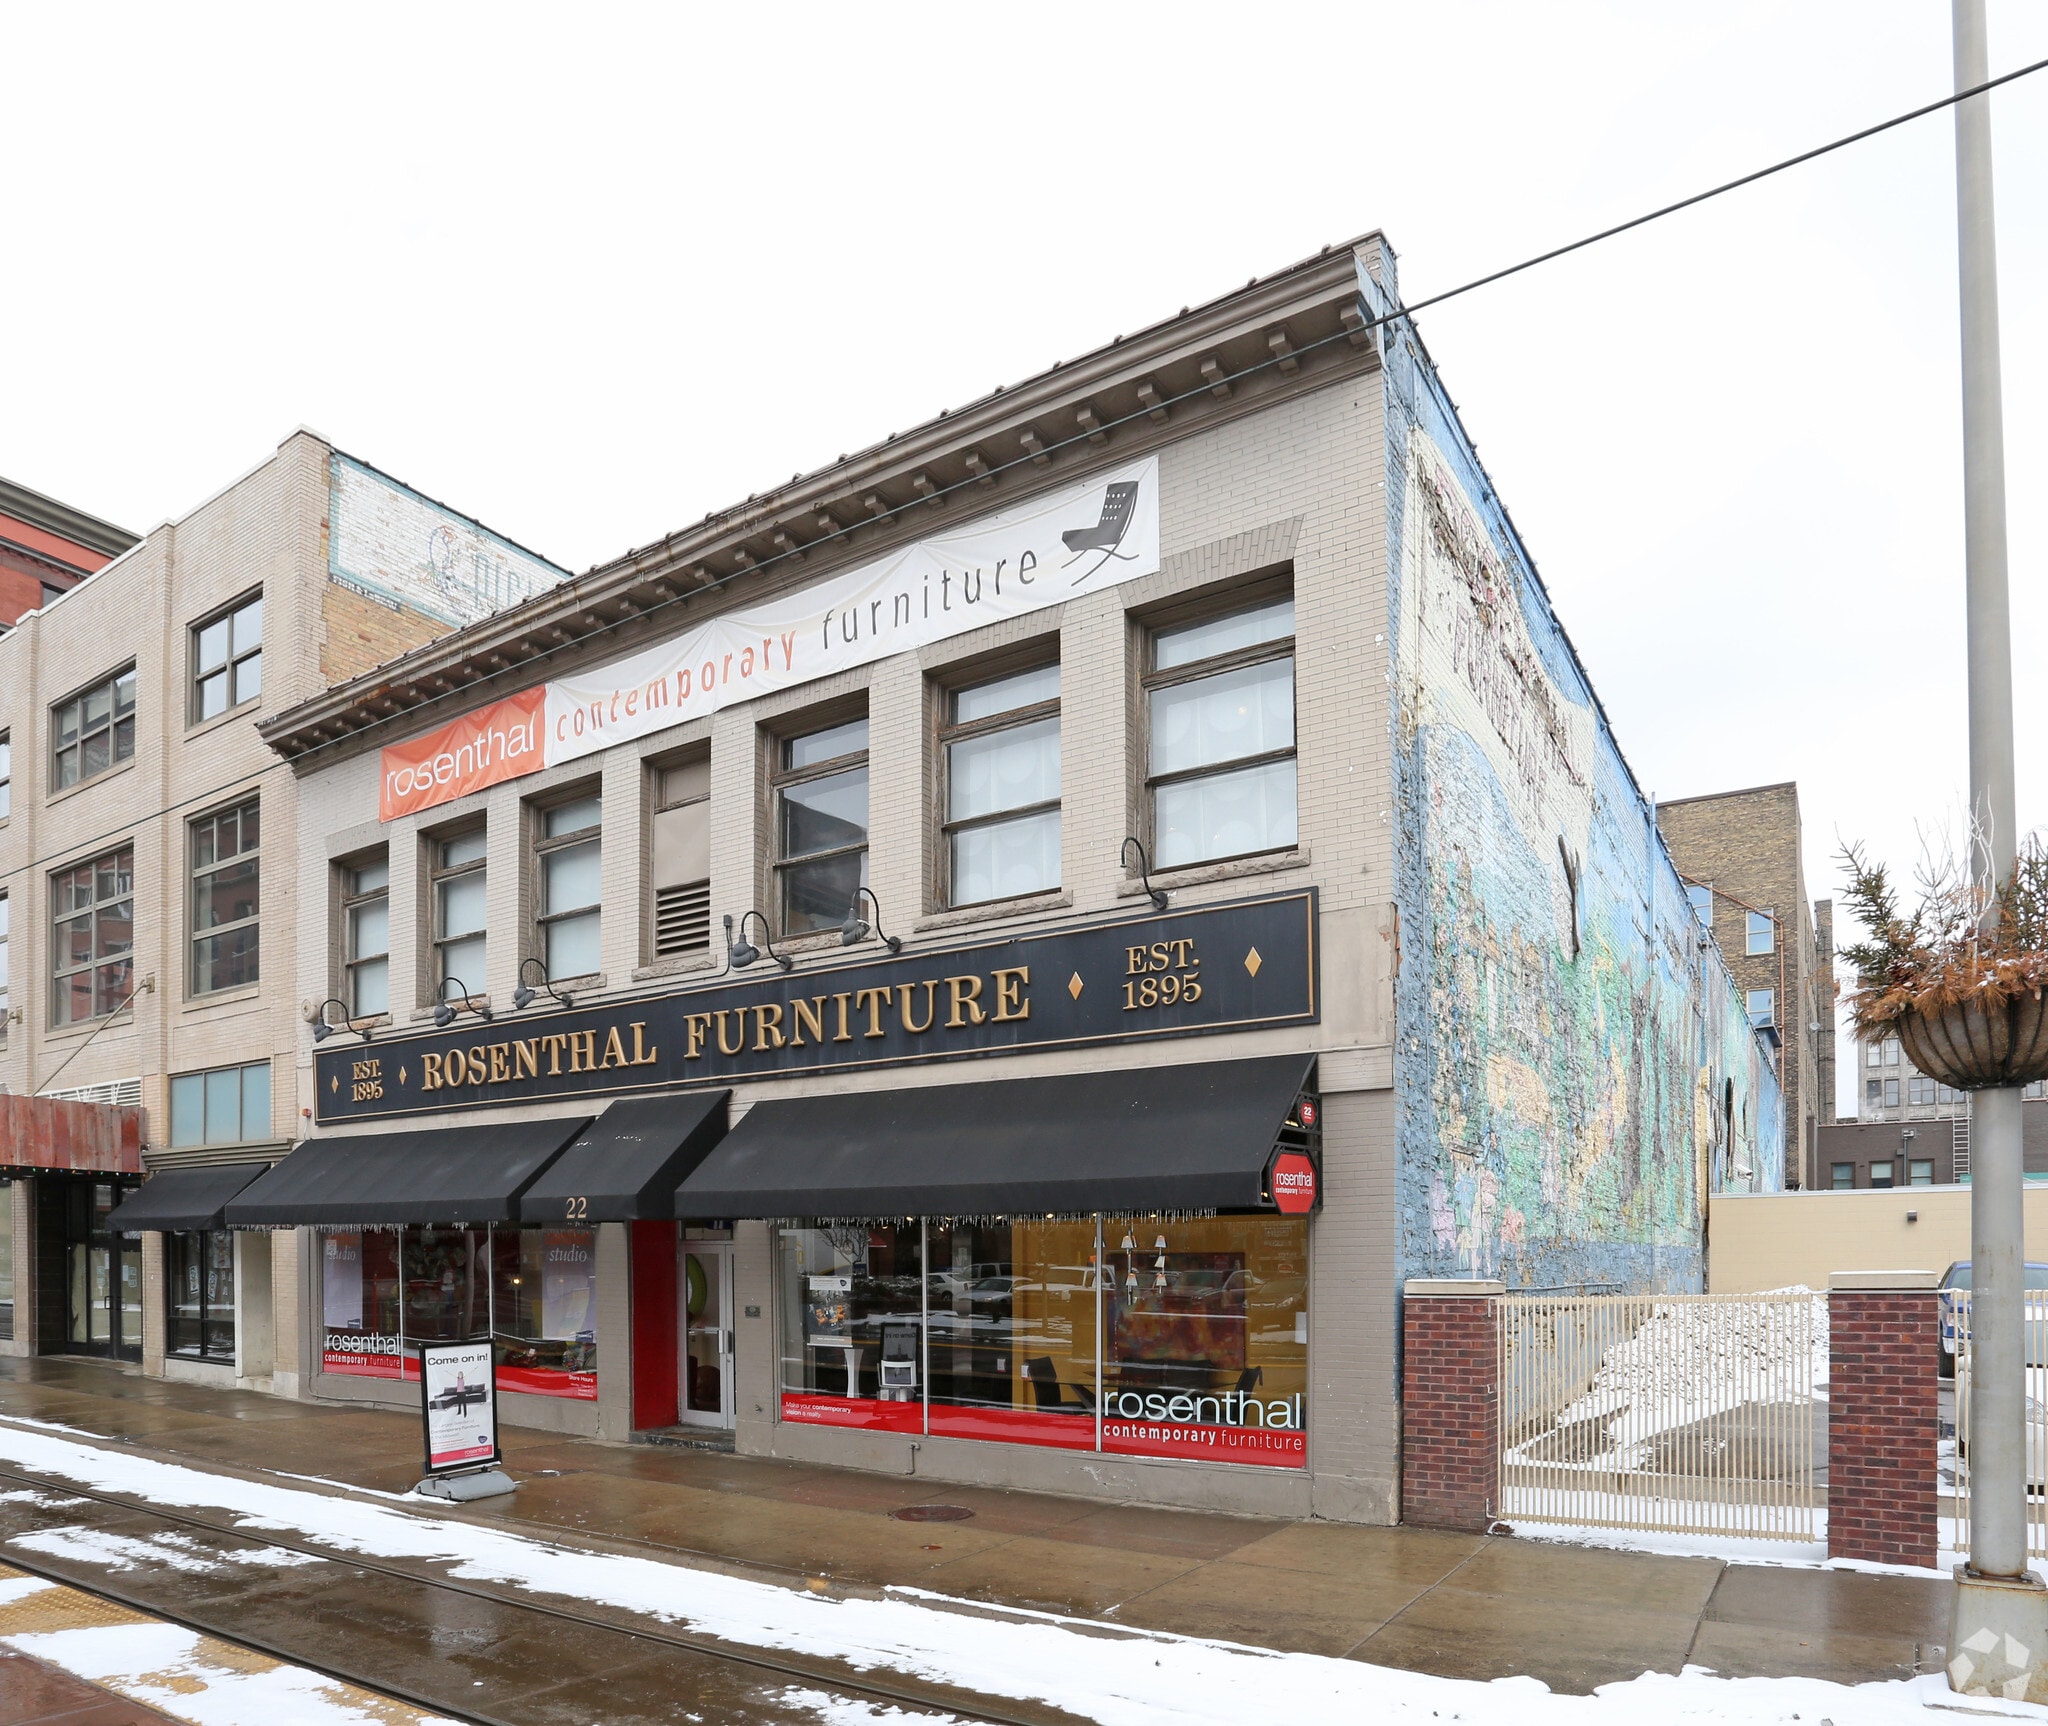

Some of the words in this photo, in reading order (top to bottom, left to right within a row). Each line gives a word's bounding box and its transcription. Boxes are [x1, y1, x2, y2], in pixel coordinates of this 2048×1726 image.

[386, 711, 537, 803] rosenthal
[556, 629, 797, 743] contemporary
[822, 549, 1038, 650] furniture
[1125, 938, 1201, 975] EST.
[1122, 971, 1203, 1011] 1895
[421, 1021, 658, 1091] ROSENTHAL
[683, 965, 1031, 1060] FURNITURE
[351, 1058, 383, 1080] EST.
[351, 1079, 384, 1102] 1895
[1303, 1106, 1312, 1117] 22
[1275, 1171, 1313, 1187] rosenthal
[1275, 1187, 1298, 1195] contemporary
[565, 1196, 588, 1219] 22
[549, 1244, 587, 1263] studio
[326, 1331, 400, 1356] rosenthal
[324, 1353, 367, 1367] contemporary
[369, 1355, 401, 1368] furniture
[427, 1356, 459, 1366] Come
[461, 1355, 475, 1363] on
[476, 1353, 488, 1361] in!
[811, 1404, 851, 1414] contemporary
[1104, 1390, 1301, 1430] rosenthal
[1103, 1423, 1217, 1446] contemporary
[1220, 1430, 1303, 1450] furniture
